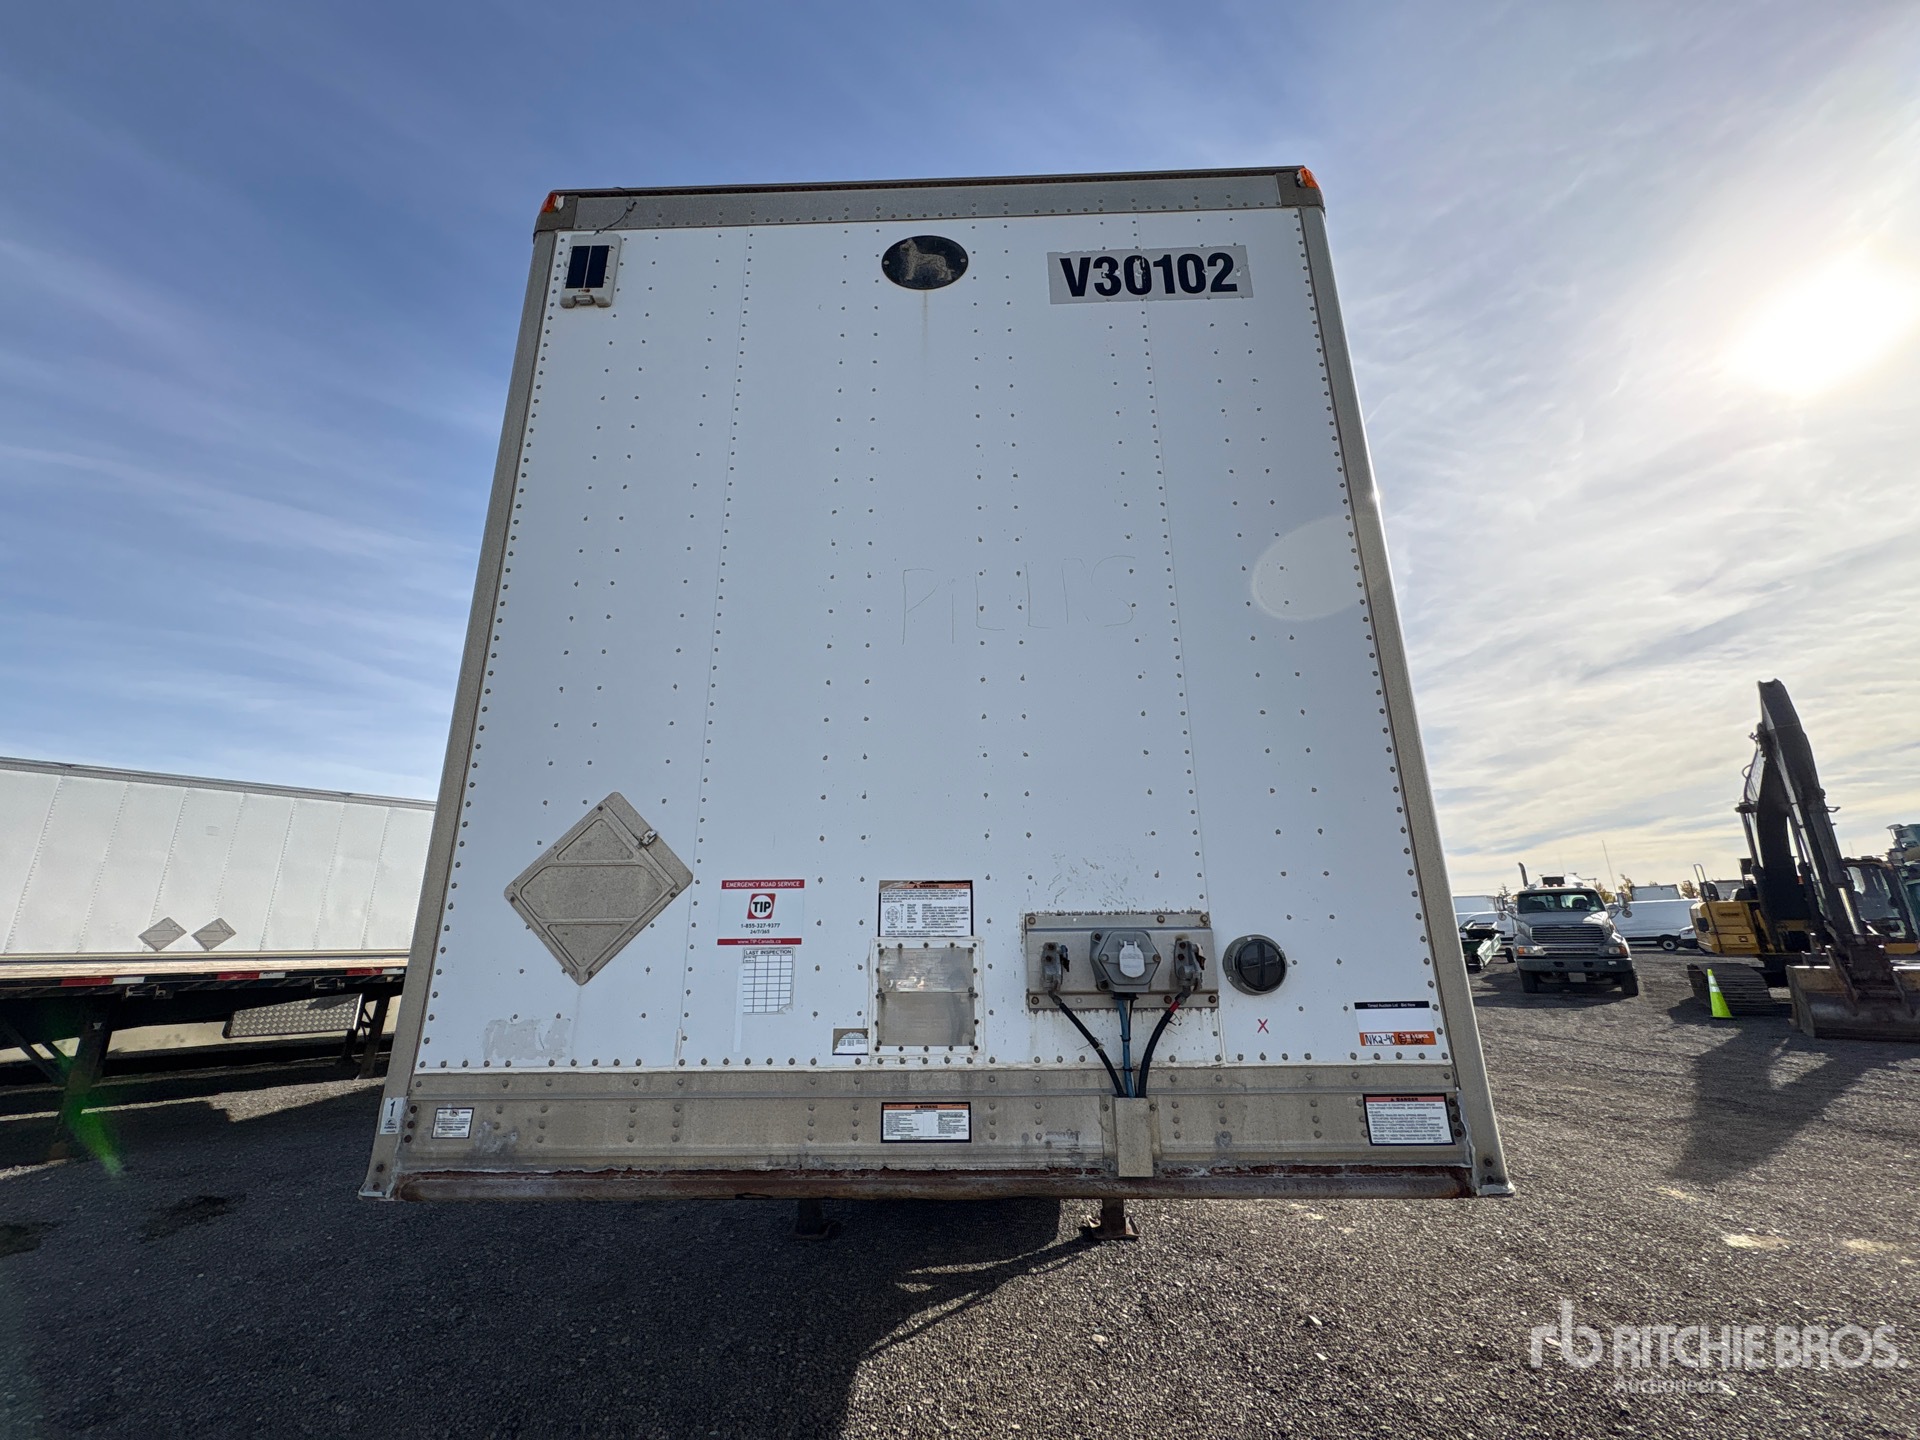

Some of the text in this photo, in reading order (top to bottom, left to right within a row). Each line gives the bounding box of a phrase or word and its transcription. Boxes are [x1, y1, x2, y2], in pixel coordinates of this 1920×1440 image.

[1059, 252, 1238, 297] V30102
[752, 901, 771, 913] TIP
[390, 1100, 396, 1117] 1
